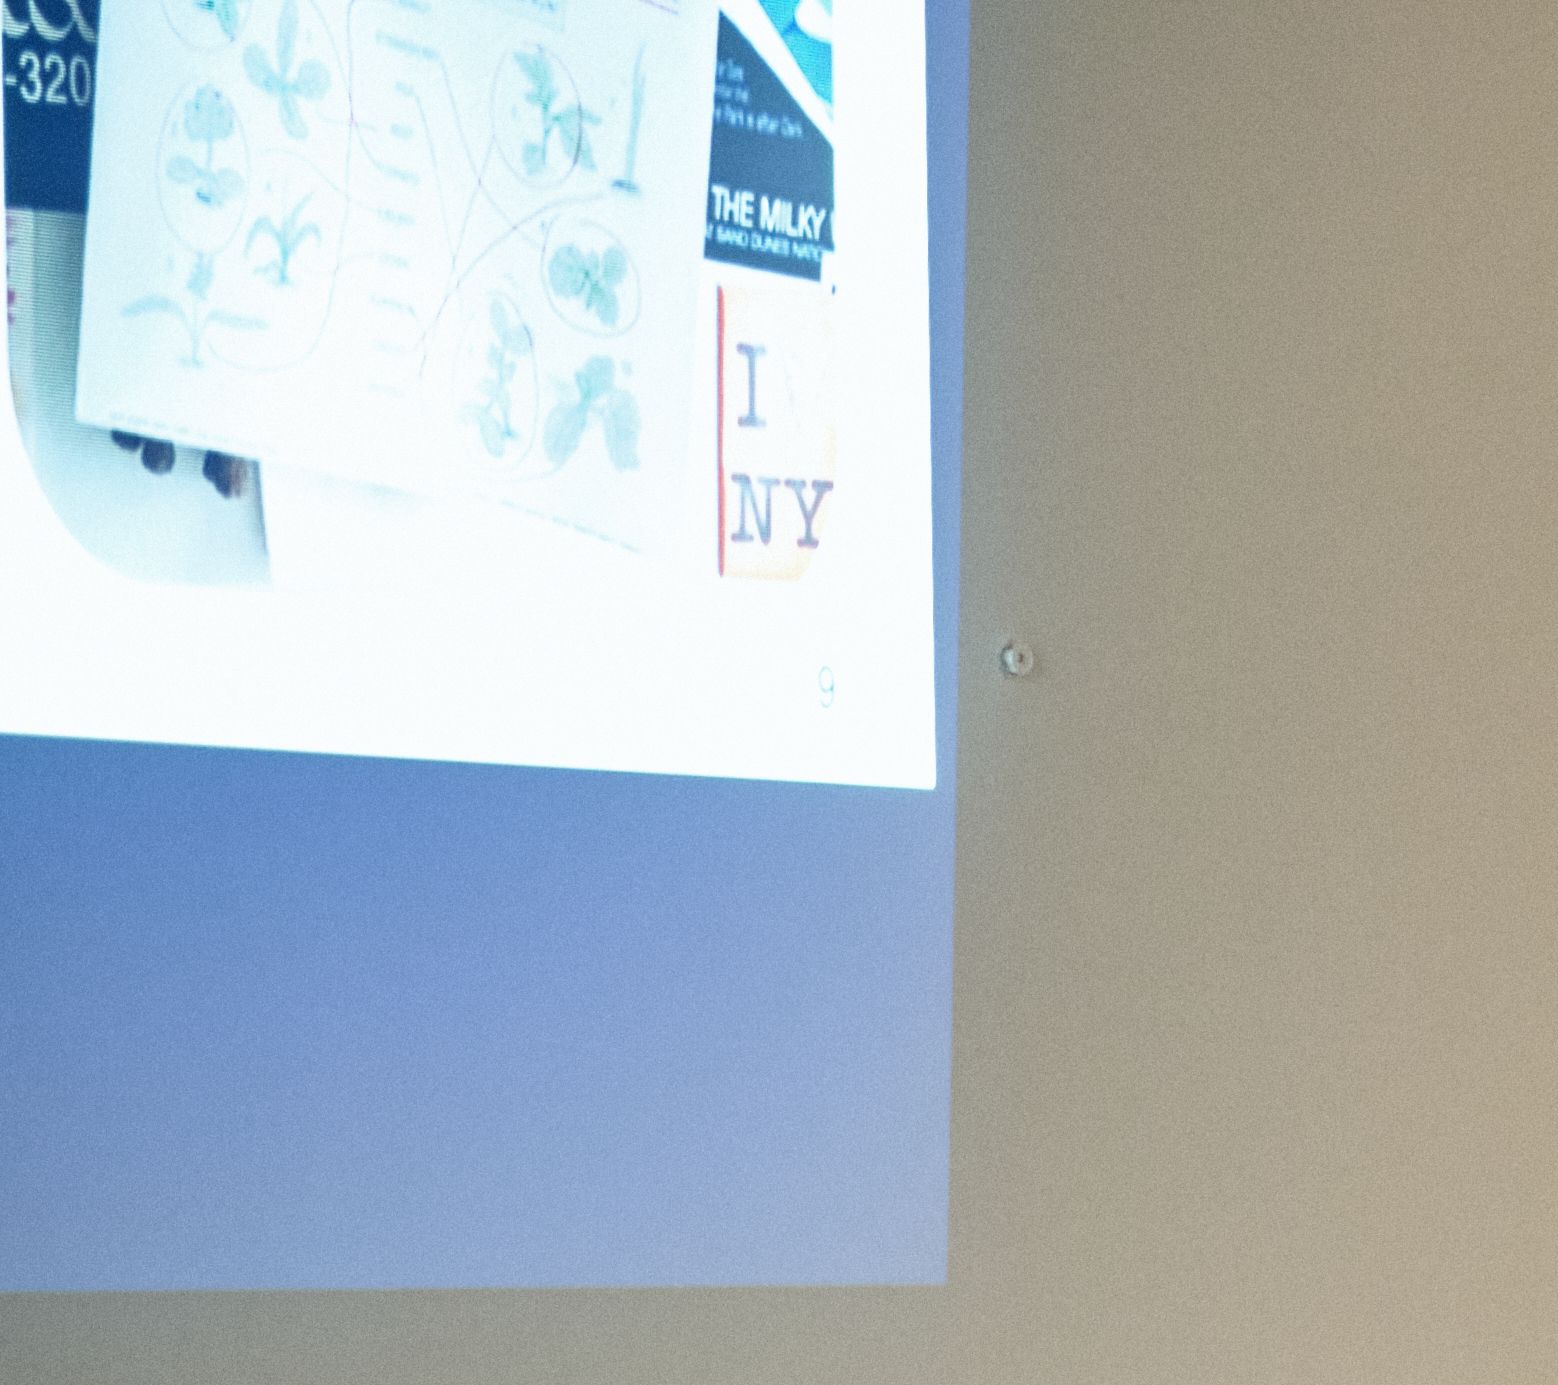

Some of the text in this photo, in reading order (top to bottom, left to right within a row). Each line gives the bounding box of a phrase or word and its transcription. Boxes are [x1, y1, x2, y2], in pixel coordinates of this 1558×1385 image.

[711, 185, 755, 228] THE
[759, 195, 826, 240] MILKY
[736, 341, 767, 427] I
[731, 473, 834, 549] NY
[819, 665, 835, 708] 9
